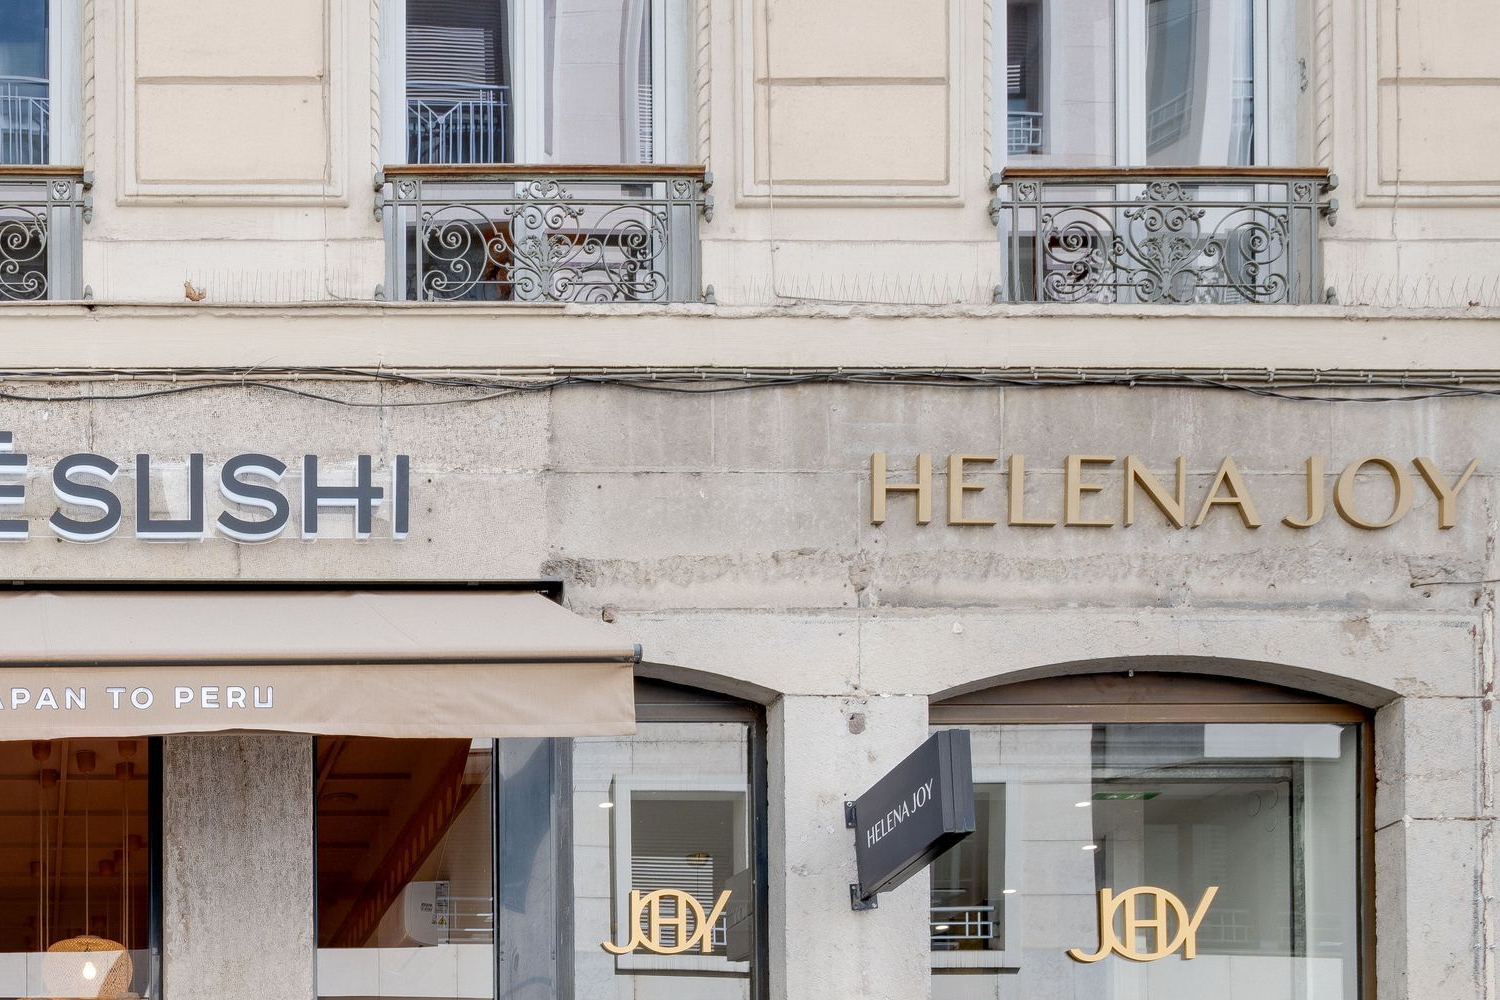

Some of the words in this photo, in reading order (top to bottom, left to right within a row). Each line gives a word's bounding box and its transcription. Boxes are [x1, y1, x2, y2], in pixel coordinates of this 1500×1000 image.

[870, 452, 1263, 530] HELENA
[1281, 456, 1480, 531] JOY
[106, 685, 155, 711] TO
[173, 684, 275, 710] PERU
[867, 800, 910, 849] HELENA
[911, 777, 934, 814] JOY
